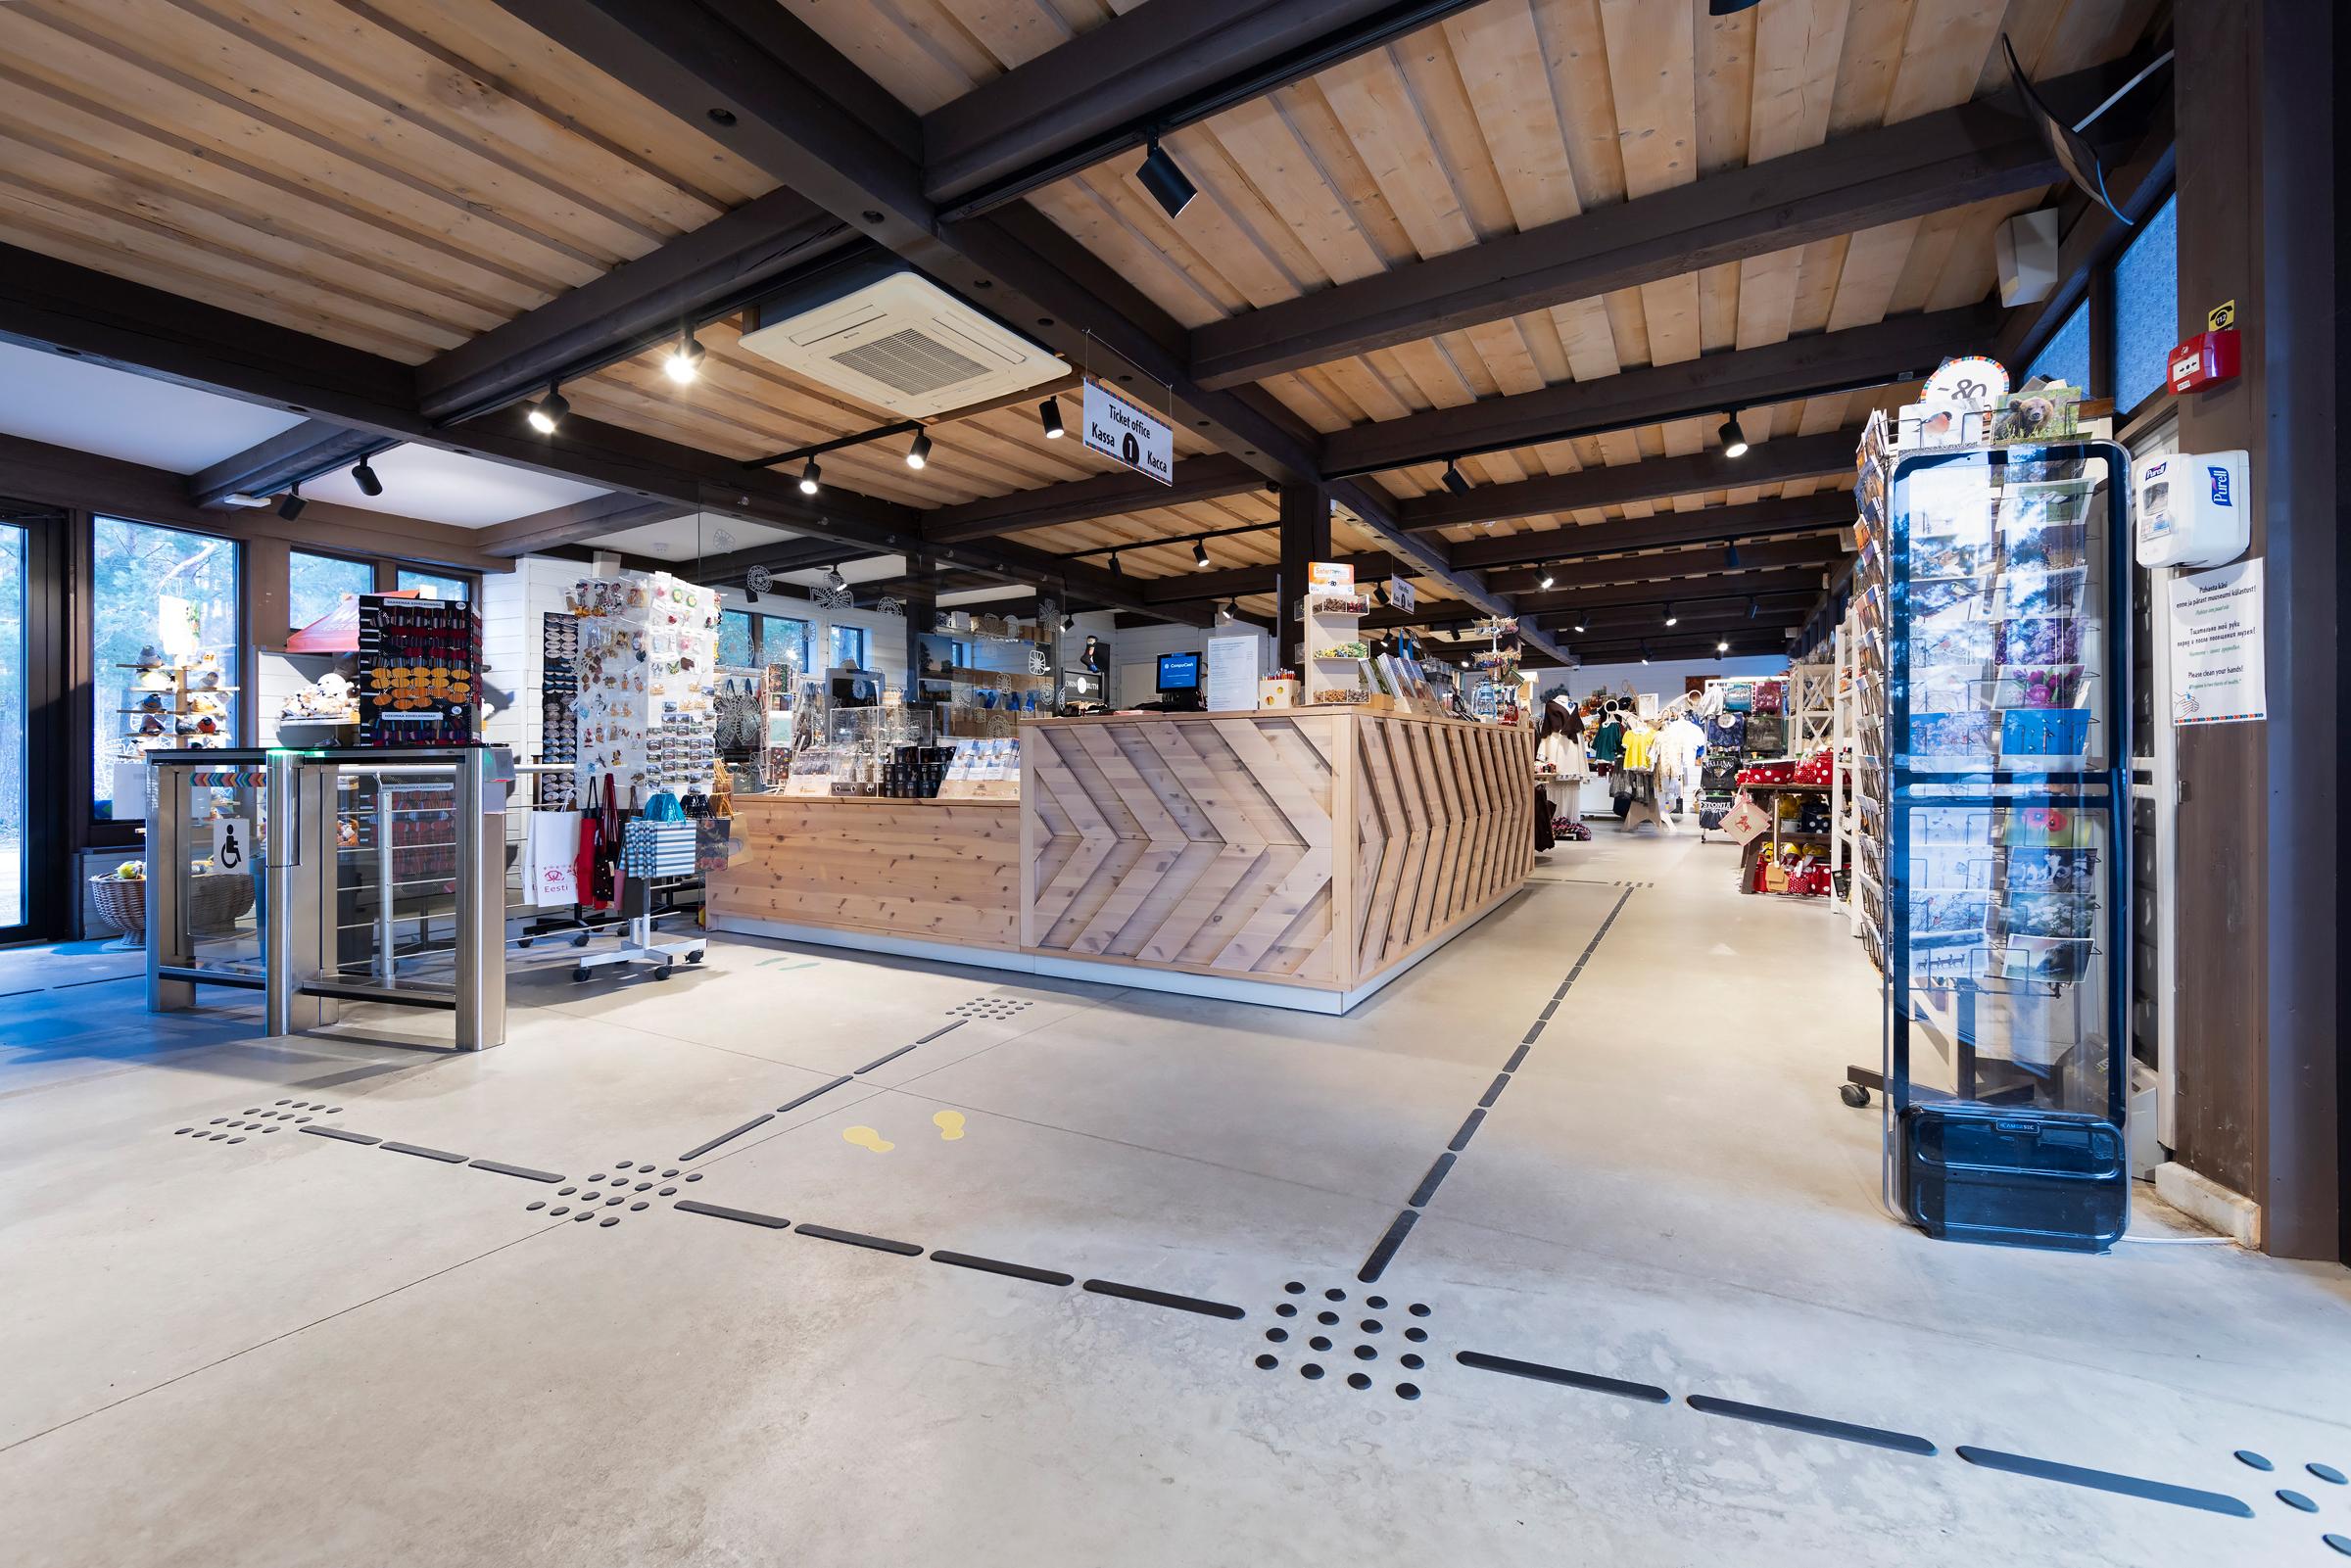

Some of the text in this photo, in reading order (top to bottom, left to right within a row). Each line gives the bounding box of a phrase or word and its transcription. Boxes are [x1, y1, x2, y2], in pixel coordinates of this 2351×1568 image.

[2217, 313, 2227, 324] 112
[1109, 404, 1150, 439] Ticket office
[1091, 422, 1115, 447] Kassa
[1128, 440, 1132, 458] 1
[2146, 466, 2164, 479] Purell
[2214, 471, 2227, 502] Purell
[2193, 596, 2207, 606] pärast
[2208, 591, 2231, 601] muuseumi
[2229, 620, 2240, 631] руки
[2227, 665, 2243, 674] hands!
